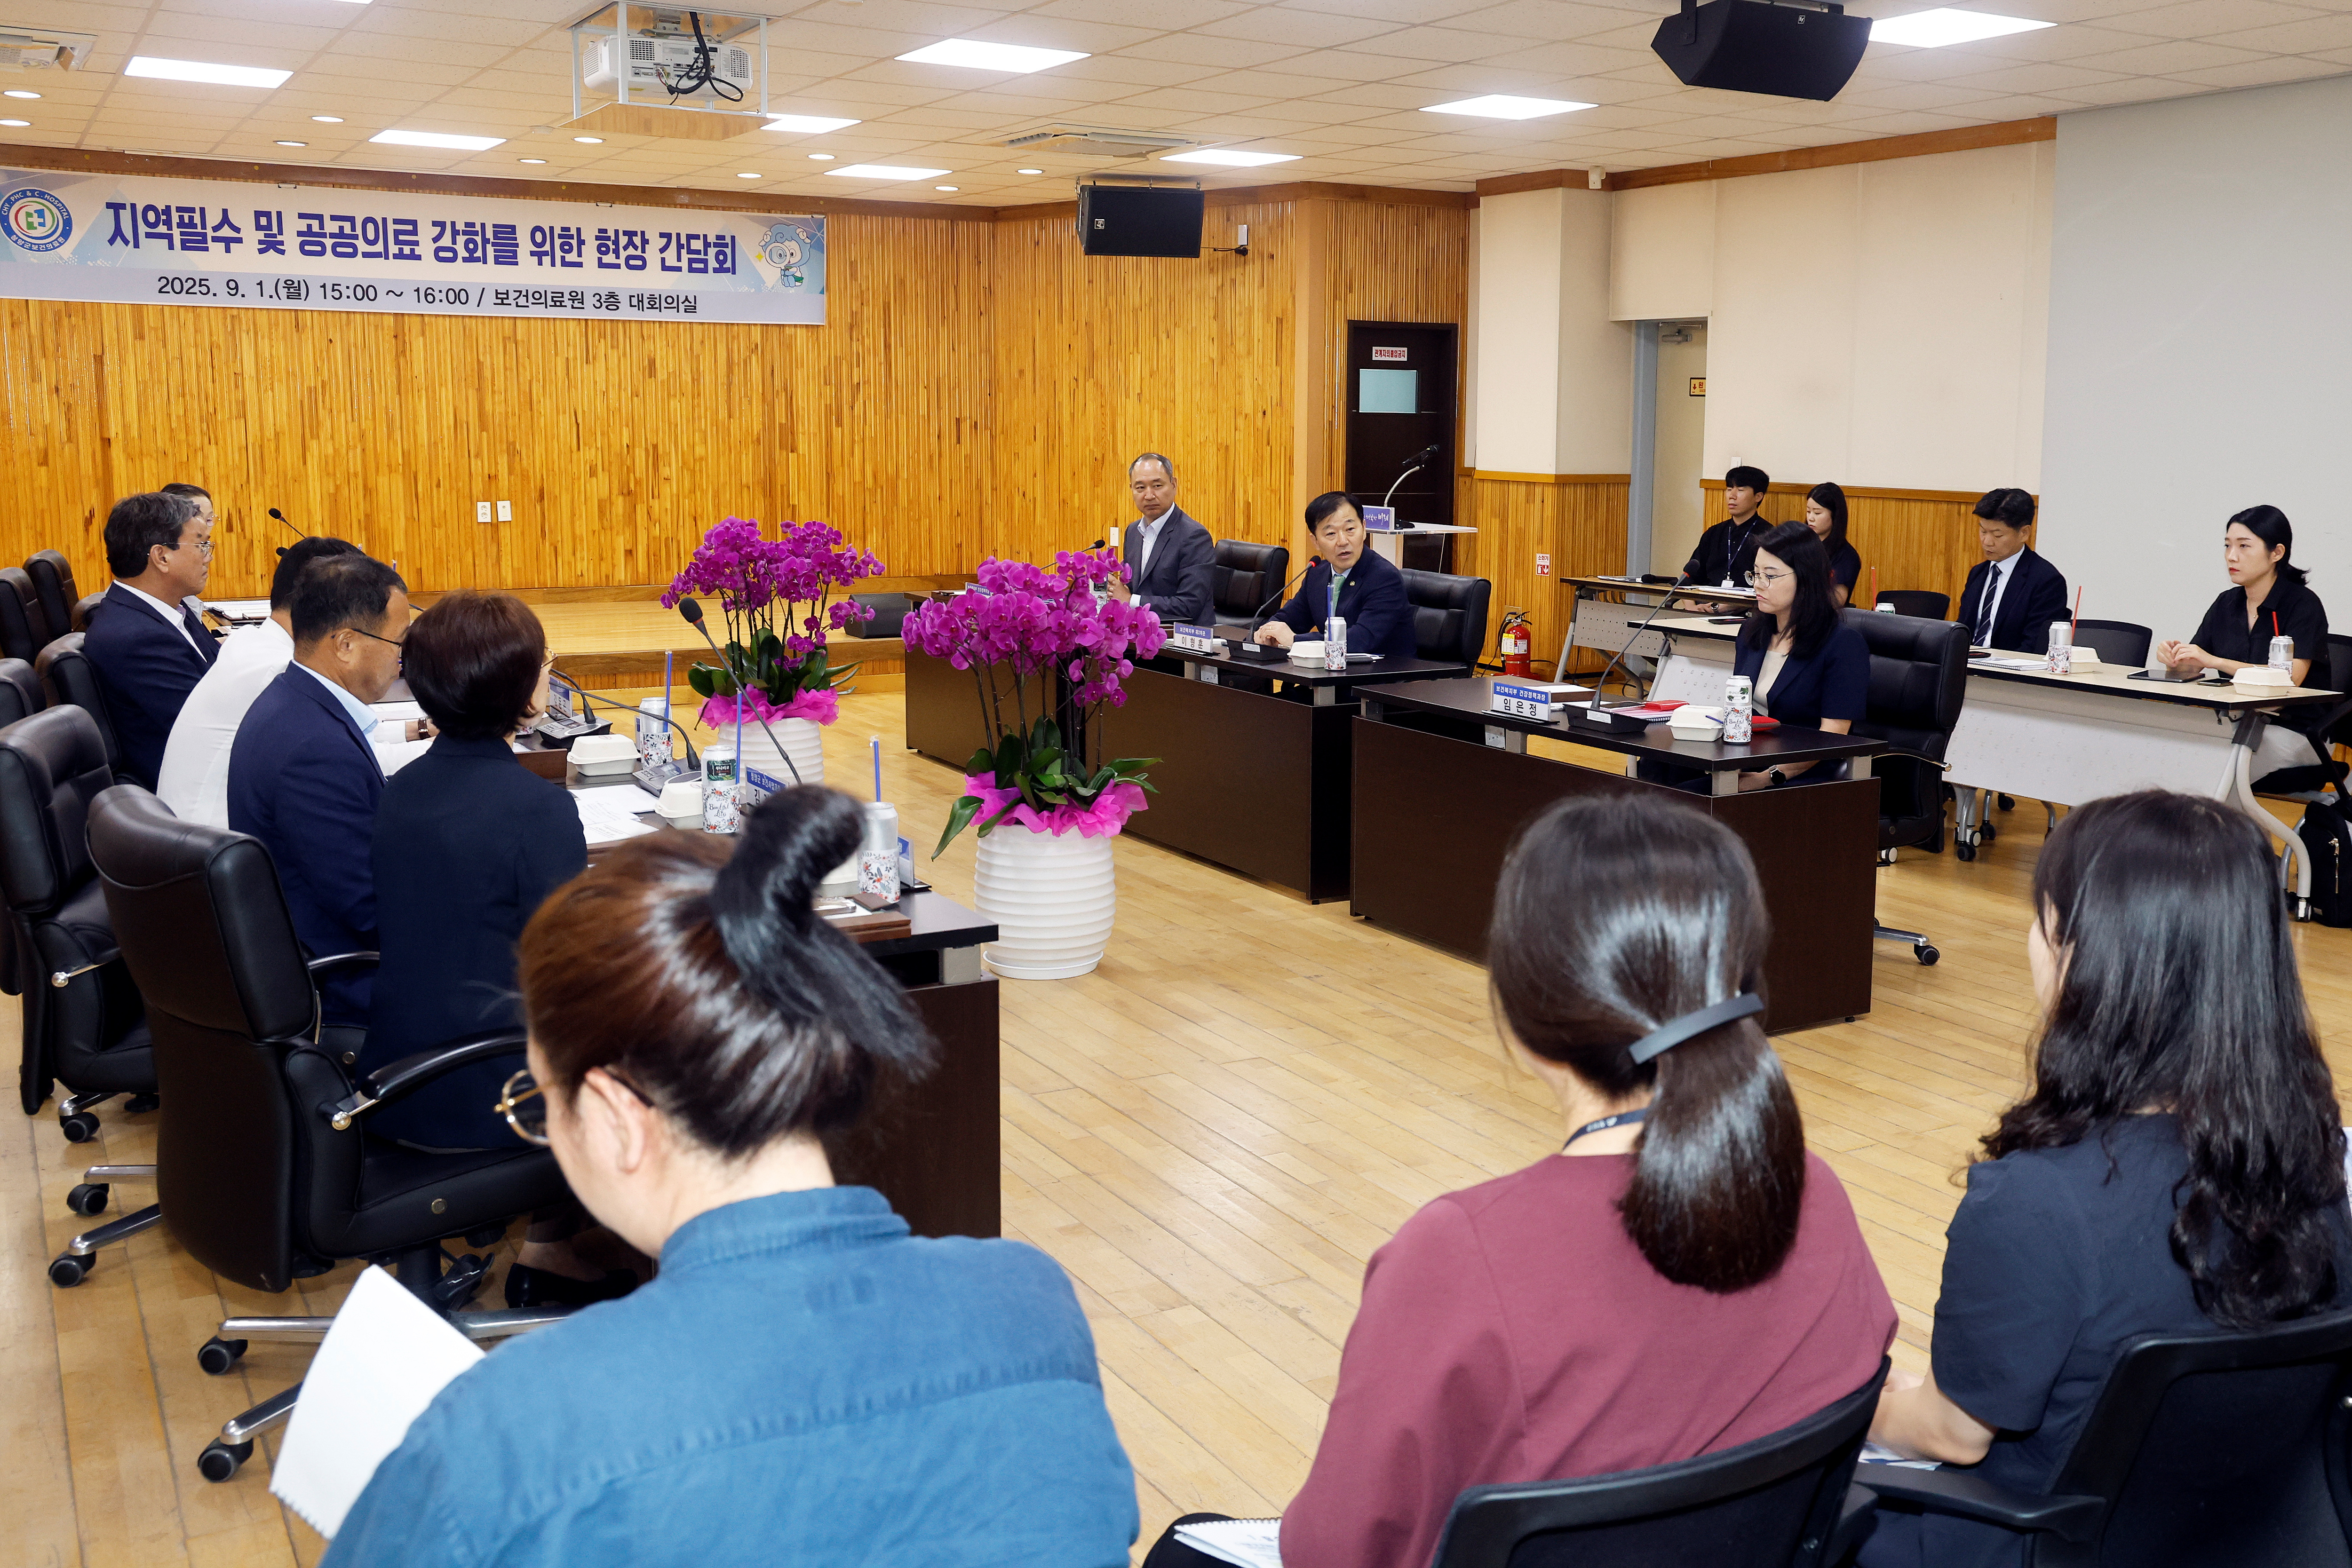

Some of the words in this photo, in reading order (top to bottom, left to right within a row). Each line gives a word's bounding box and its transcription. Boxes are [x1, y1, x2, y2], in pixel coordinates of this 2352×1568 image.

[106, 202, 243, 253] 지역필수
[255, 211, 286, 255] 및
[297, 213, 421, 261] 공공의료
[432, 221, 519, 266] 강화를
[530, 226, 585, 268] 위한
[596, 229, 649, 270] 현장
[660, 232, 737, 275] 간담회
[158, 276, 217, 297] 2025.
[226, 279, 246, 298] 9.
[319, 283, 377, 301] 15:00
[413, 287, 469, 305] 16:00
[493, 289, 585, 309] 보건의료원
[593, 292, 621, 311] 3층
[629, 293, 697, 313] 대회의실
[1496, 685, 1518, 695] 보건복지부
[1519, 689, 1546, 701] 건강정책과장
